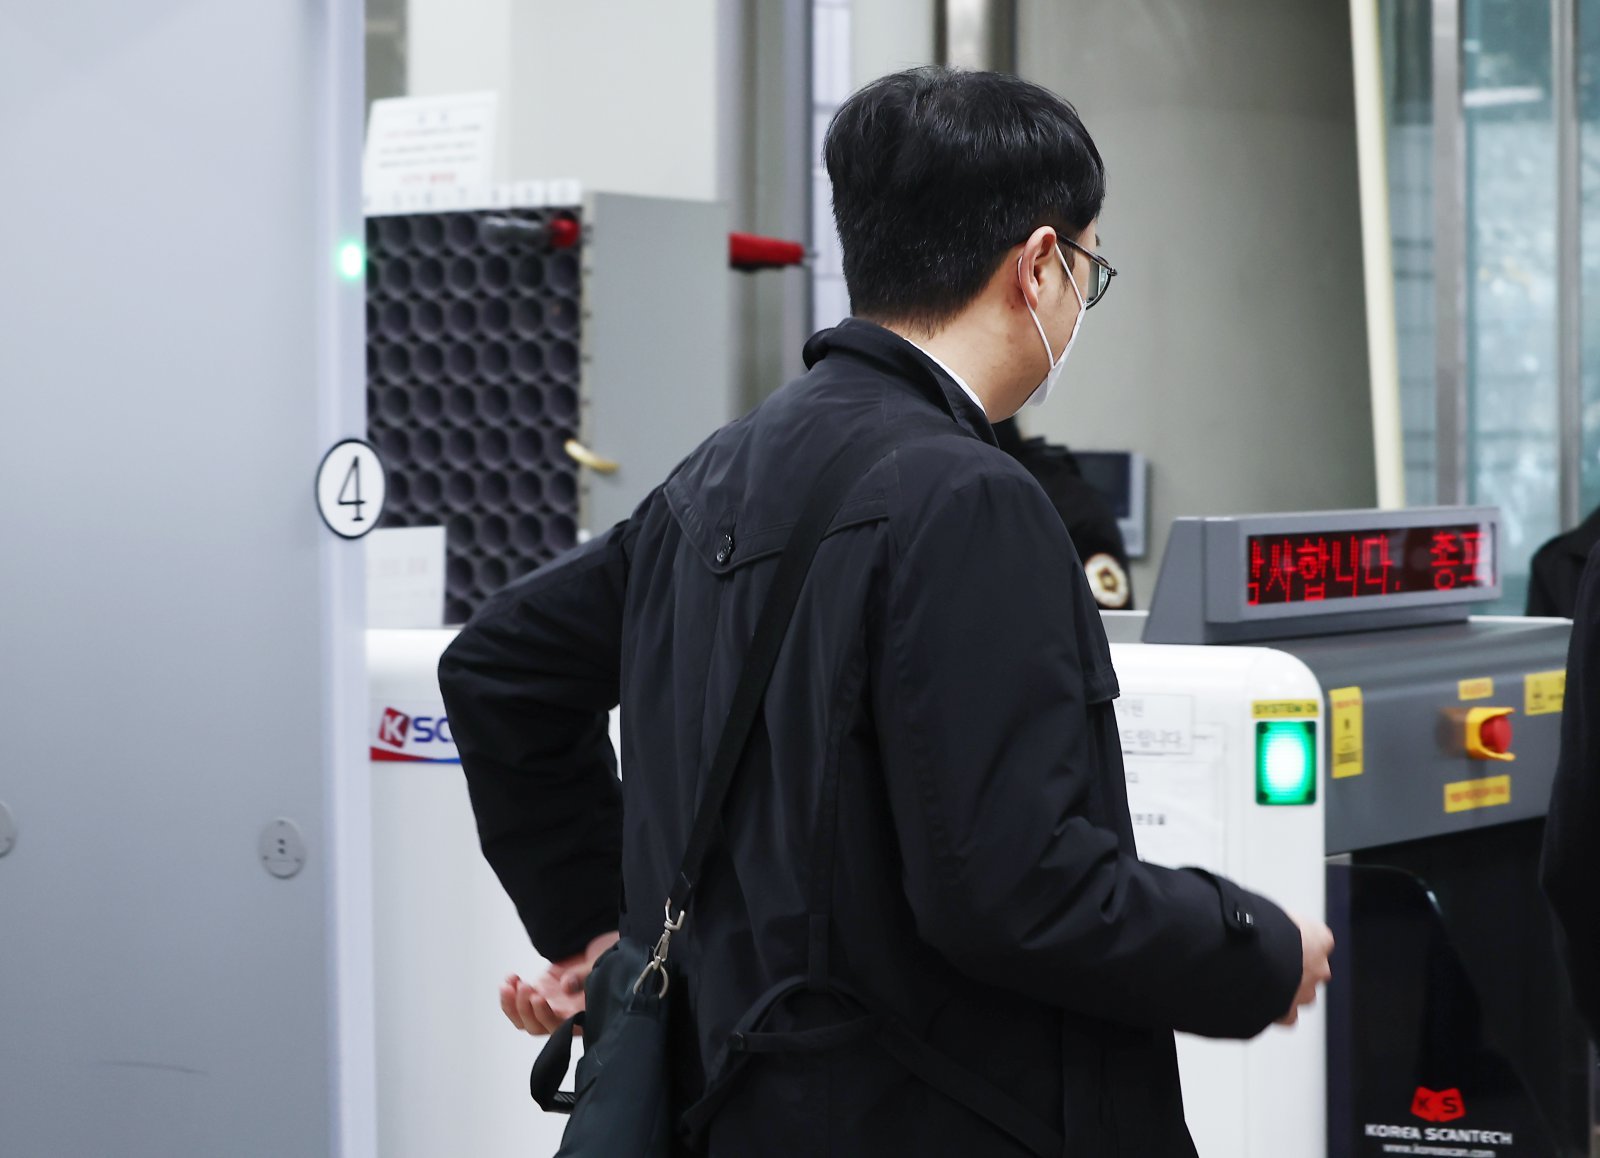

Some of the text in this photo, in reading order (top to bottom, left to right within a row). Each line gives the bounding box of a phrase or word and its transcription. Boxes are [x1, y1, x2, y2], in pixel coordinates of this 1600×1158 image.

[338, 455, 367, 521] 4
[1365, 1124, 1513, 1145] KOREA SCANTECH
